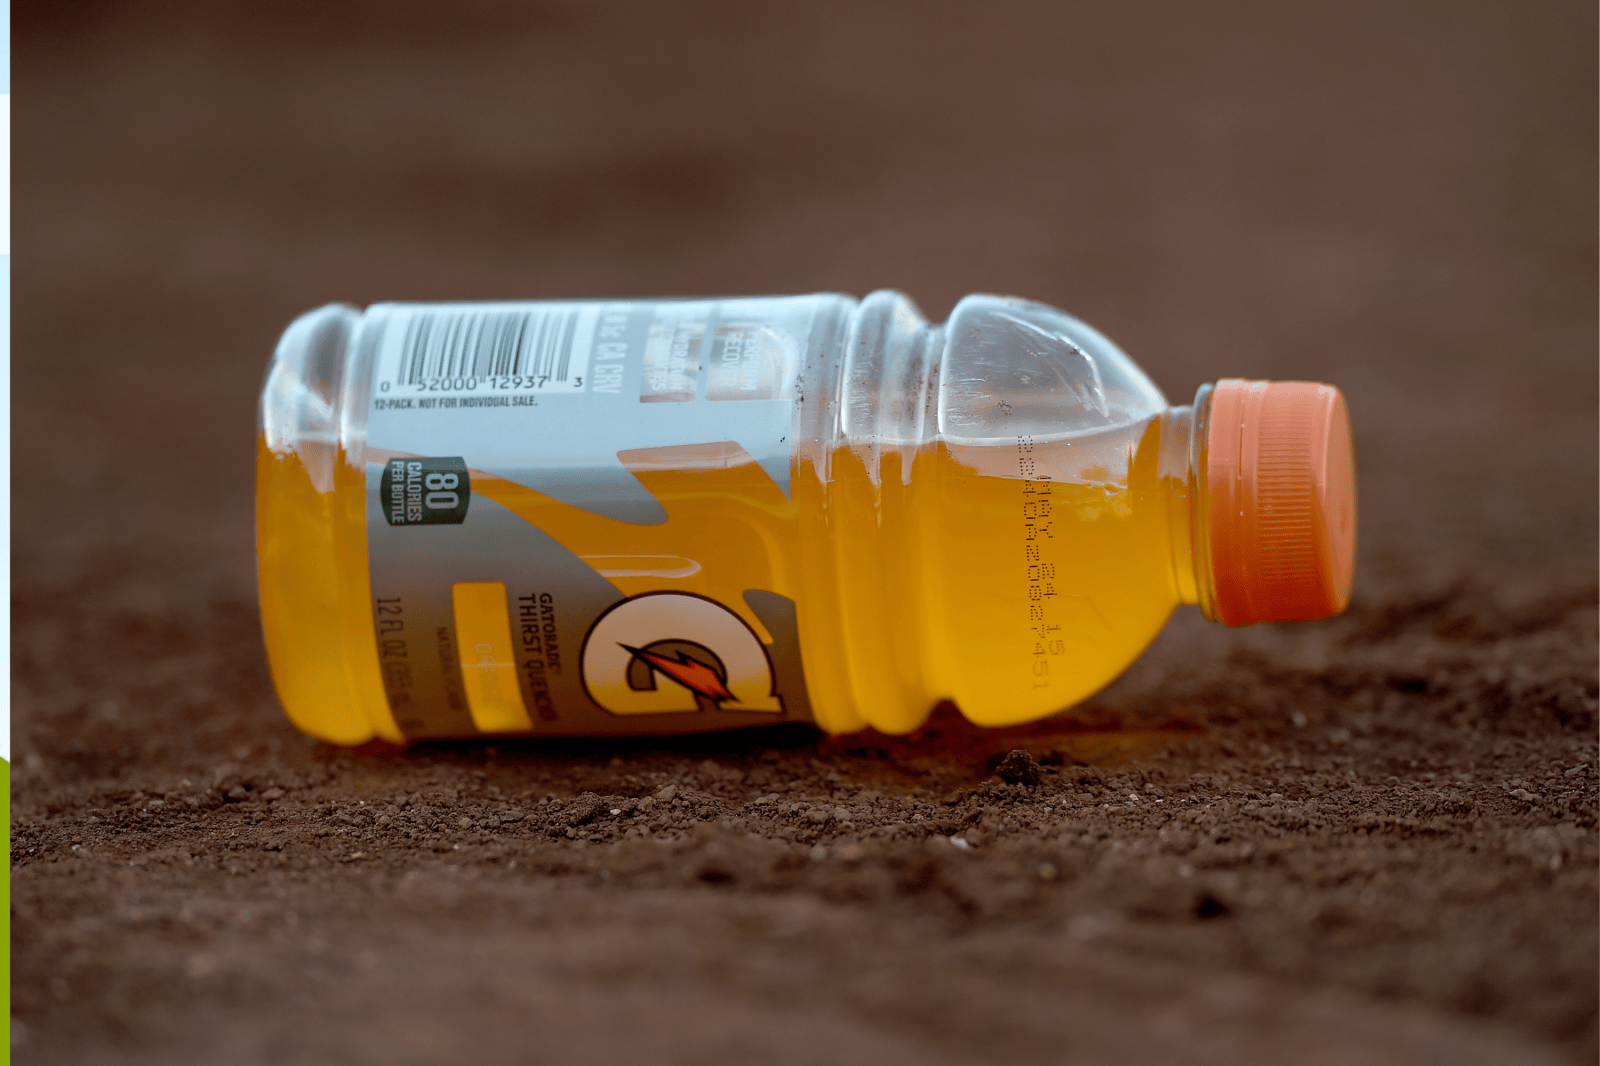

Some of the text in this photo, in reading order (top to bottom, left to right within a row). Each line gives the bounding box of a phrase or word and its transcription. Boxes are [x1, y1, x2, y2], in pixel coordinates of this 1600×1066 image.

[597, 342, 628, 361] CA
[381, 376, 583, 392] 0 52000 12937 3
[592, 364, 625, 394] CRV
[374, 396, 538, 410] 12-PACK. NOT FOR INDIVIDUAL SALE.
[391, 461, 405, 524] PER BOTTLE
[407, 461, 423, 521] CALORIES
[425, 473, 459, 509] 80
[1037, 476, 1065, 655] MAY 24 15
[377, 597, 403, 615] 12
[379, 620, 404, 637] FL
[517, 592, 542, 655] THIRST
[539, 592, 562, 671] GATORADE
[382, 639, 408, 658] OZ
